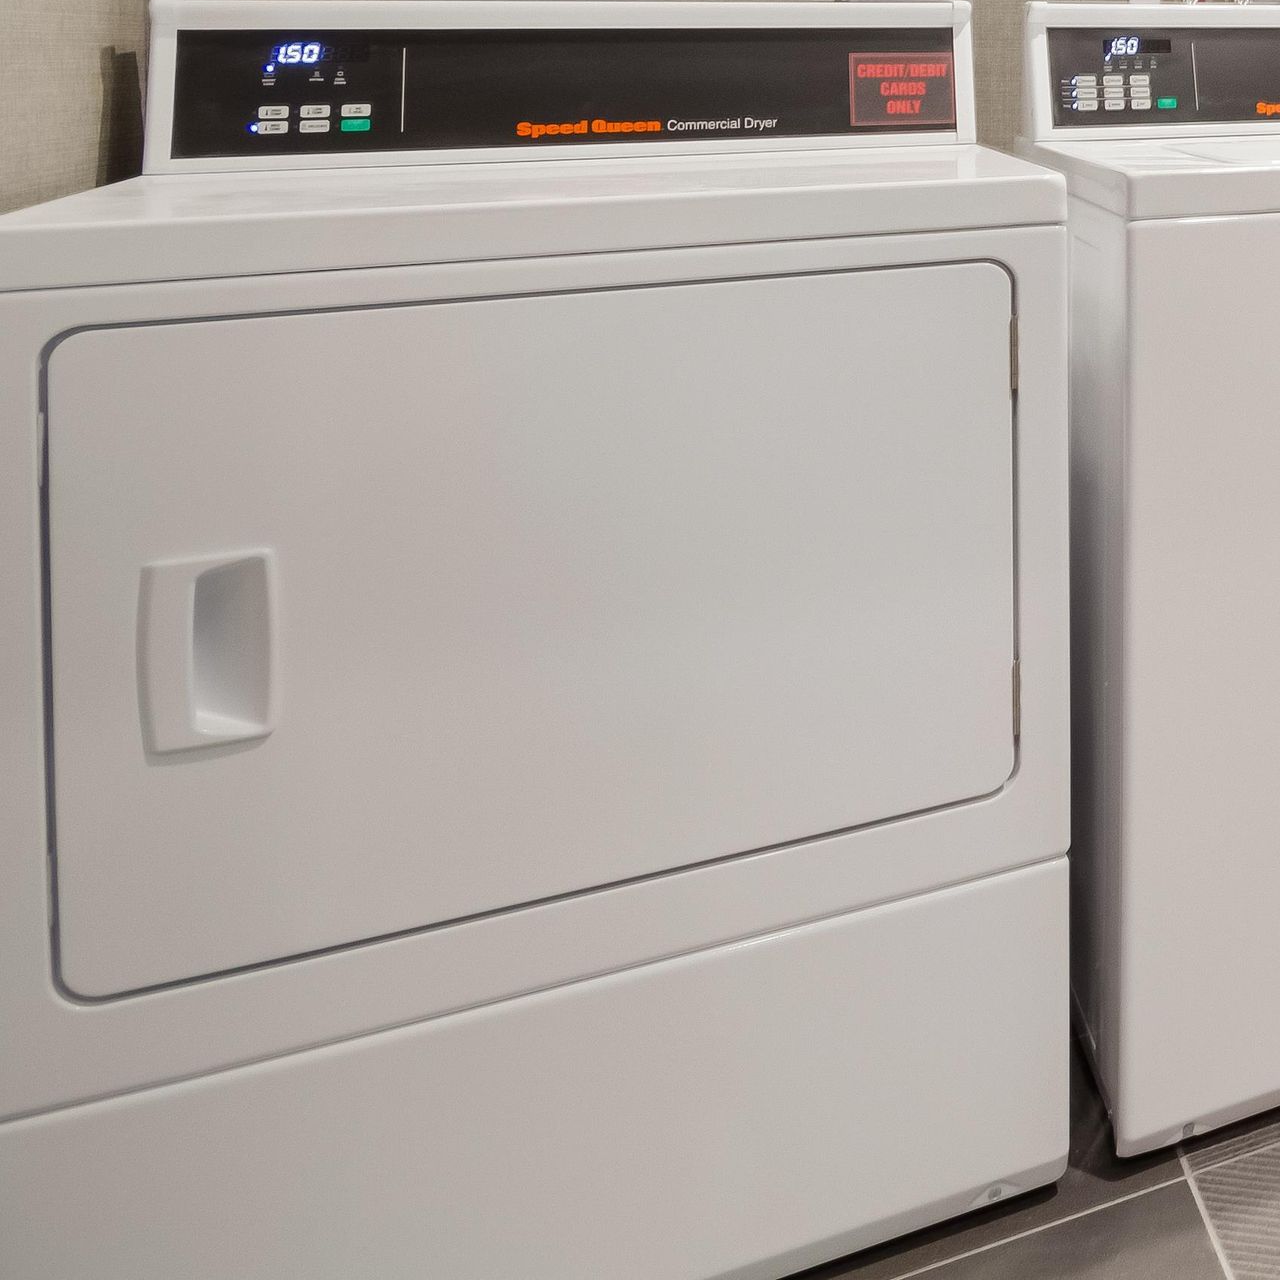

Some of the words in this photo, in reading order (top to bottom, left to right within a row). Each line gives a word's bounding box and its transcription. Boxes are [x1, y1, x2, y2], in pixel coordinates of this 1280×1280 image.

[857, 64, 947, 78] CREDIT/DEBIT
[880, 81, 926, 96] CARDS
[886, 100, 922, 114] ONLY
[517, 120, 588, 138] Speed
[592, 119, 661, 132] Queen
[667, 118, 740, 131] Commercial
[744, 117, 778, 131] Dryer
